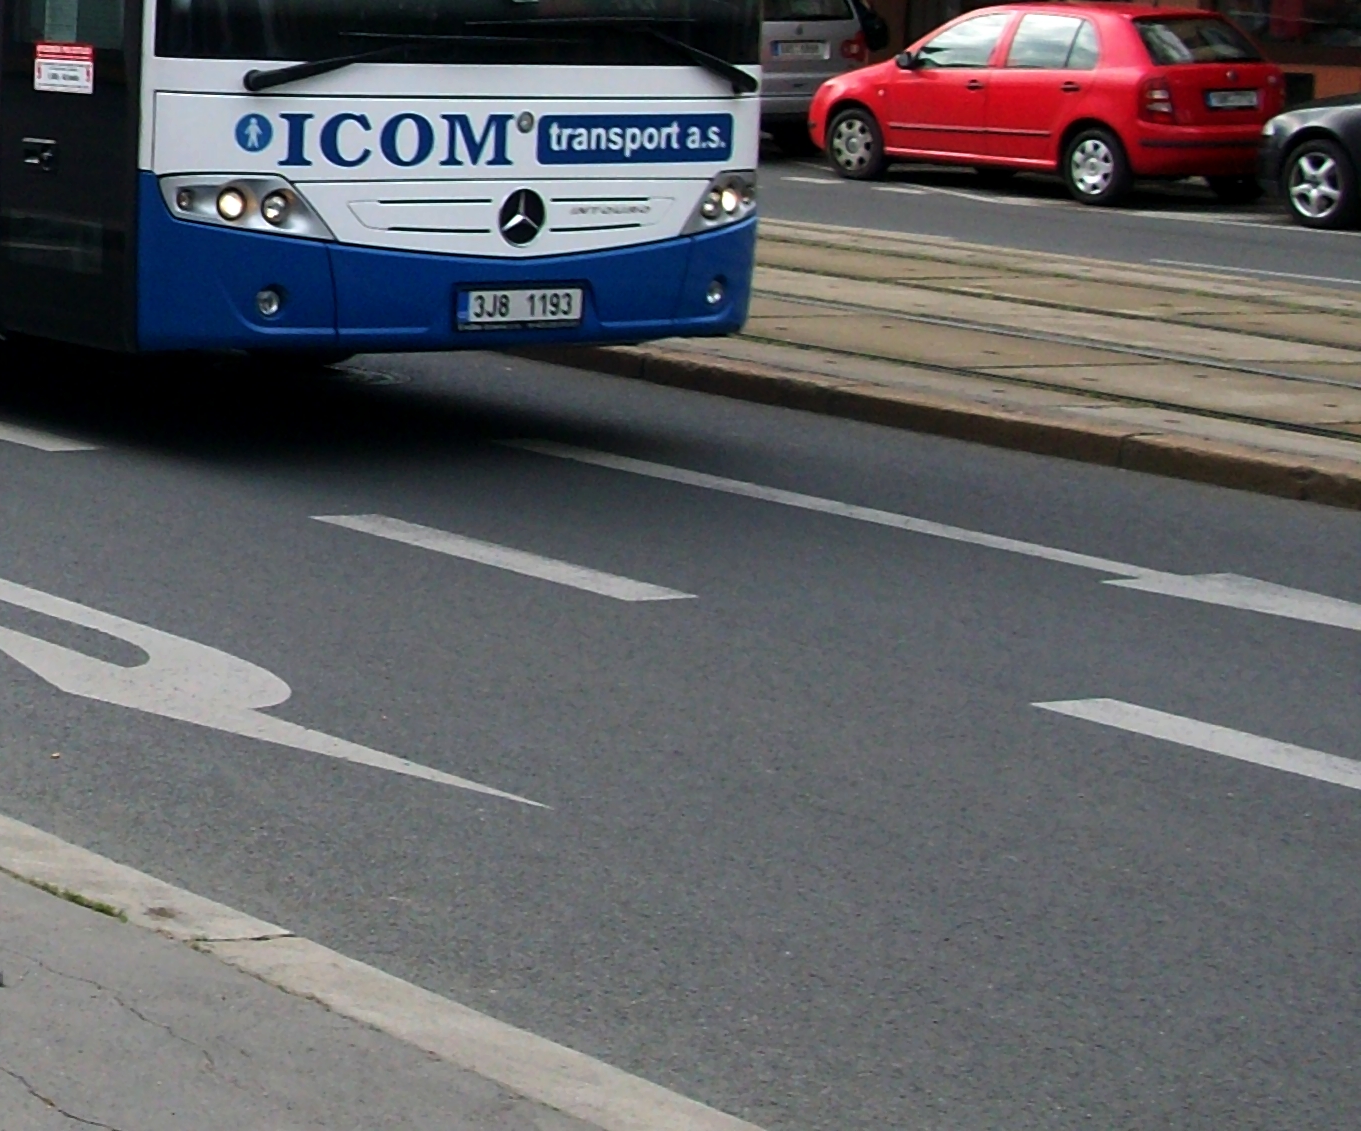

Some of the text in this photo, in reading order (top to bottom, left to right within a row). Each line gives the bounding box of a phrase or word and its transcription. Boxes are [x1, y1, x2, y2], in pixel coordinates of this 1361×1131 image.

[277, 112, 727, 168] ICOM transport a.s.
[473, 292, 573, 318] 3J8 1193
